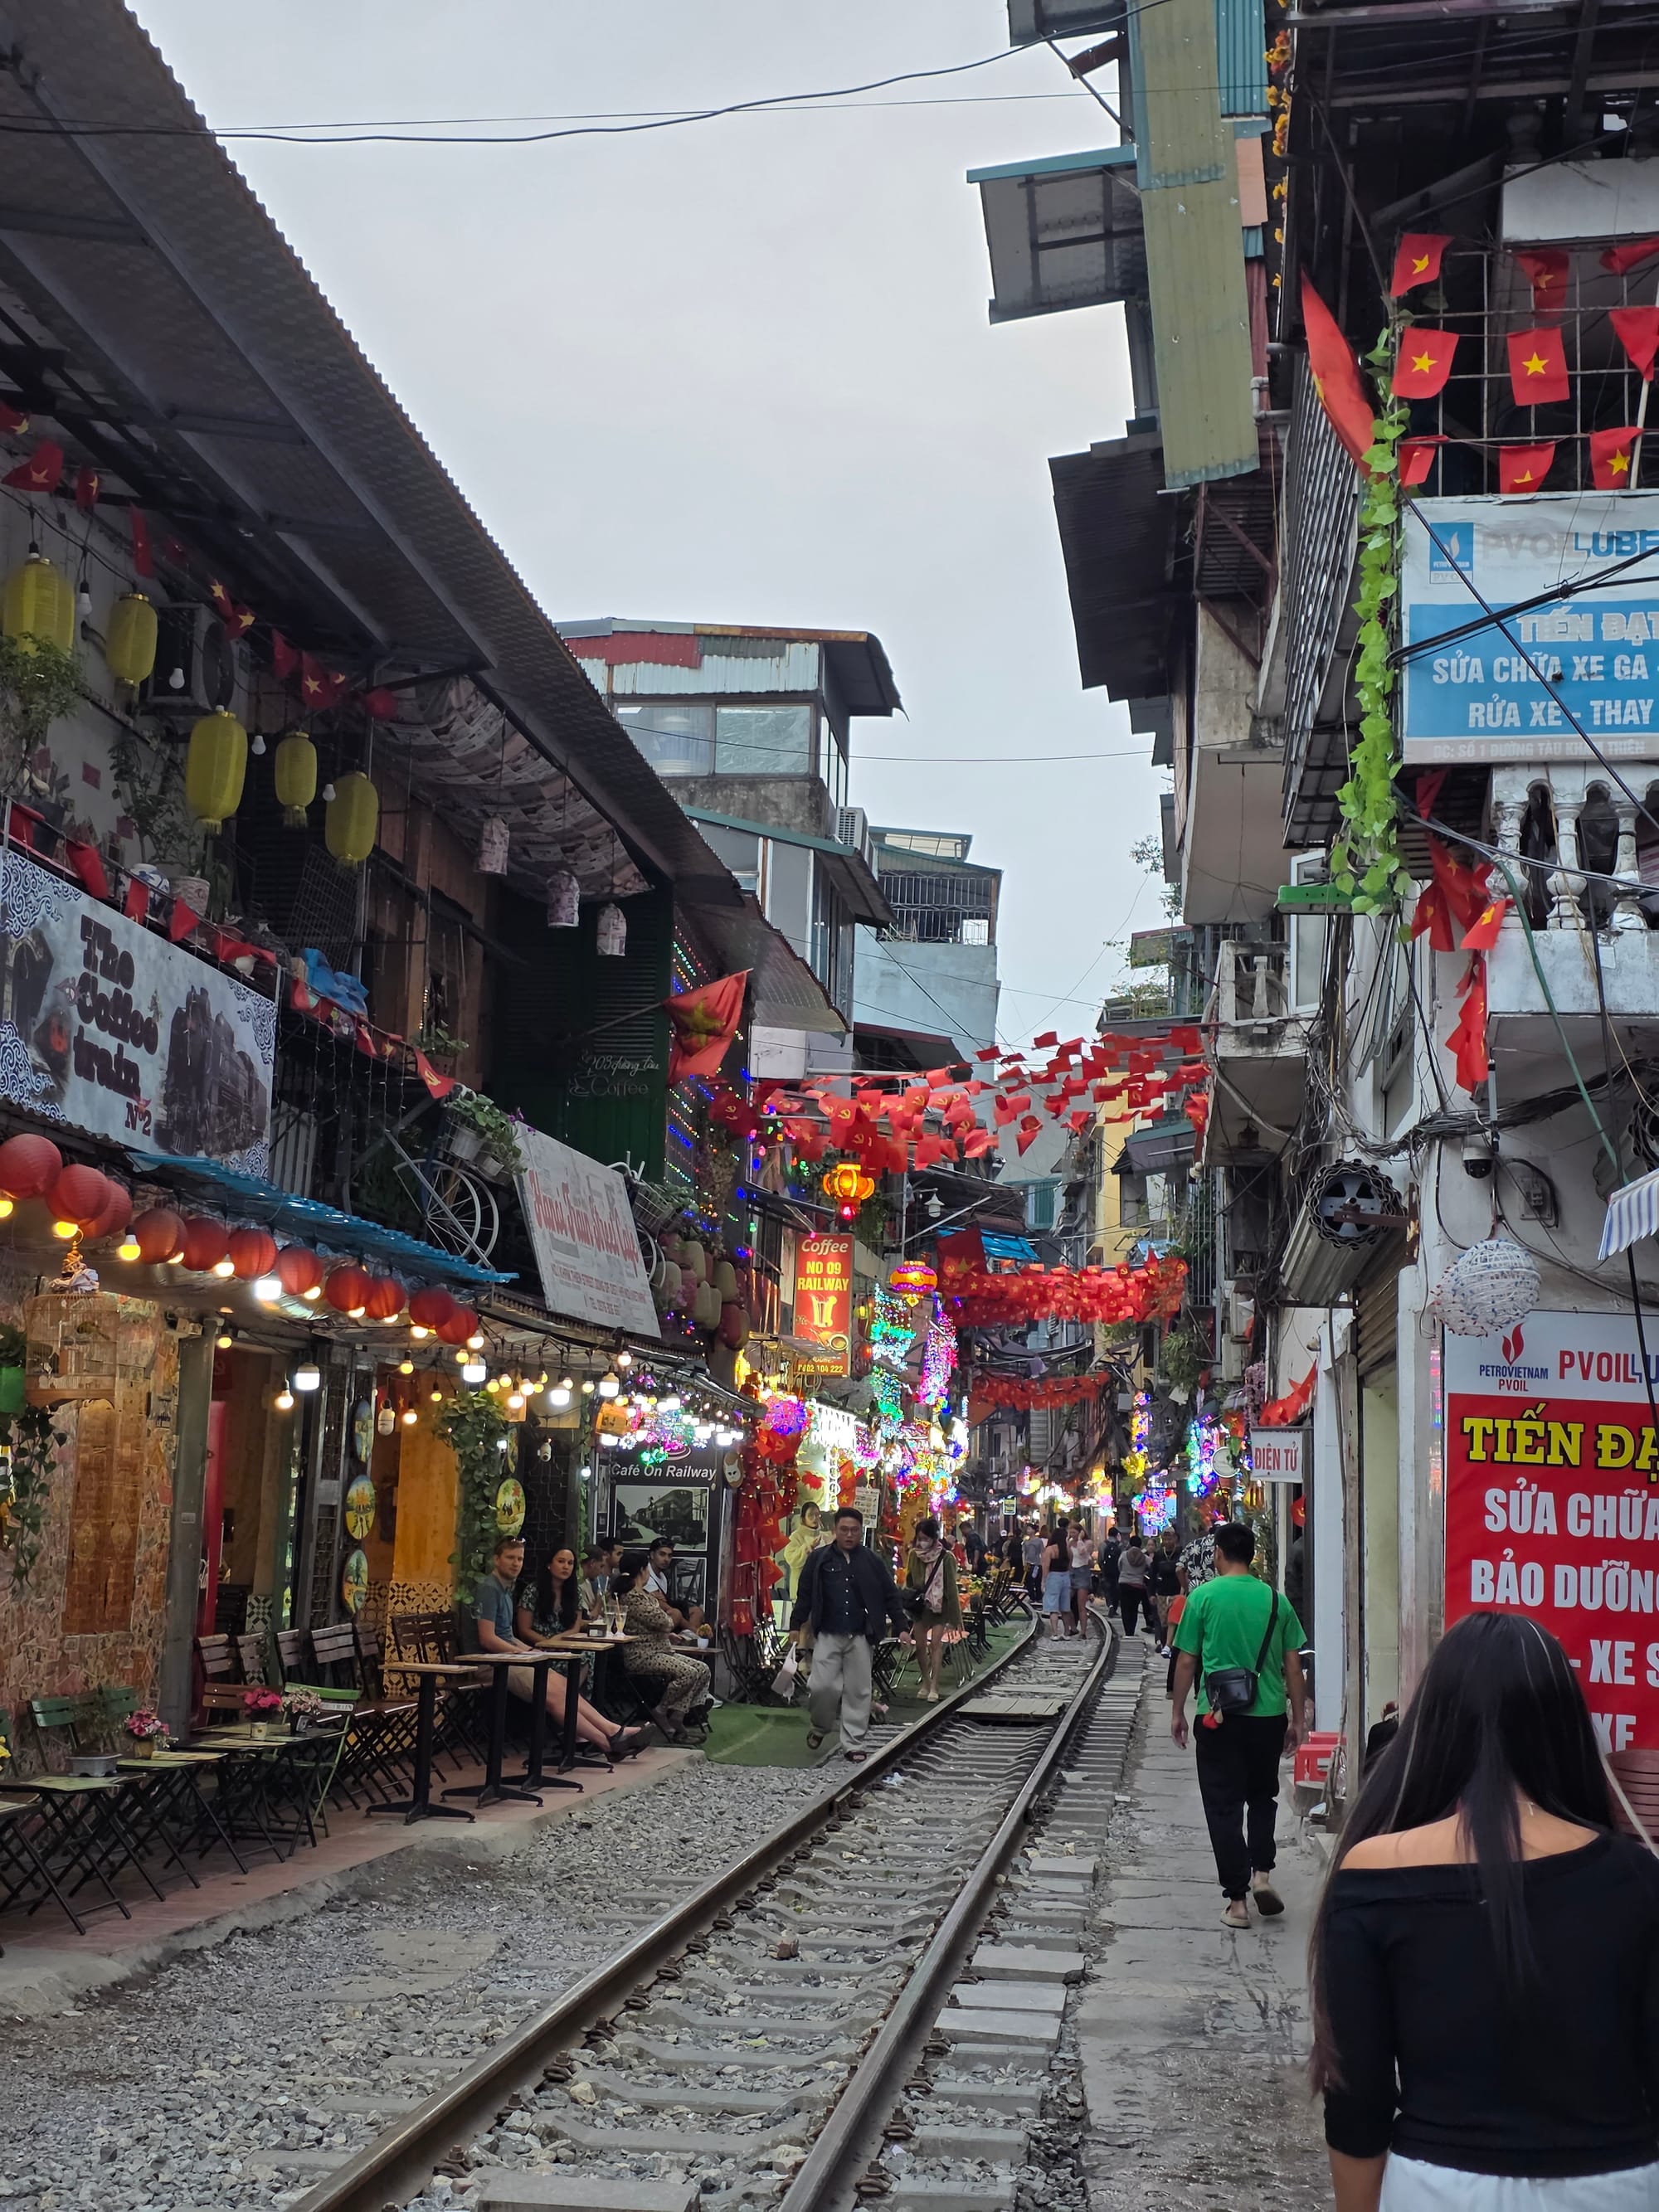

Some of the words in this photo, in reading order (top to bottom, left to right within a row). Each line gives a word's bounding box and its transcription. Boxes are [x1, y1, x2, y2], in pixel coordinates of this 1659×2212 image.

[1516, 605, 1593, 643] TIẾN
[1433, 649, 1485, 684] SỬA
[1493, 652, 1564, 683] CHỮA
[1572, 655, 1605, 681] XE
[1614, 654, 1649, 681] GA
[1468, 693, 1521, 728] RỬA
[1529, 702, 1562, 727] XE
[1589, 698, 1654, 727] THAY
[801, 1238, 849, 1256] Coffee
[797, 1277, 849, 1291] RAILWAY
[806, 1261, 824, 1275] NO
[826, 1261, 842, 1275] 09
[1479, 1364, 1549, 1380] PETROVIETNAM
[1498, 1378, 1529, 1392] PVOIL
[1462, 1402, 1584, 1466] TIẾN
[611, 1463, 640, 1476] Café
[644, 1465, 662, 1477] On
[666, 1465, 717, 1481] Railway
[1254, 1442, 1281, 1475] ĐIỆN
[1283, 1441, 1299, 1471] TỬ
[1484, 1476, 1558, 1535] SỬA
[1567, 1488, 1659, 1541] CHỮA
[1471, 1548, 1545, 1607] BẢO
[1554, 1559, 1659, 1613] DƯỠN
[1588, 1639, 1636, 1685] XE
